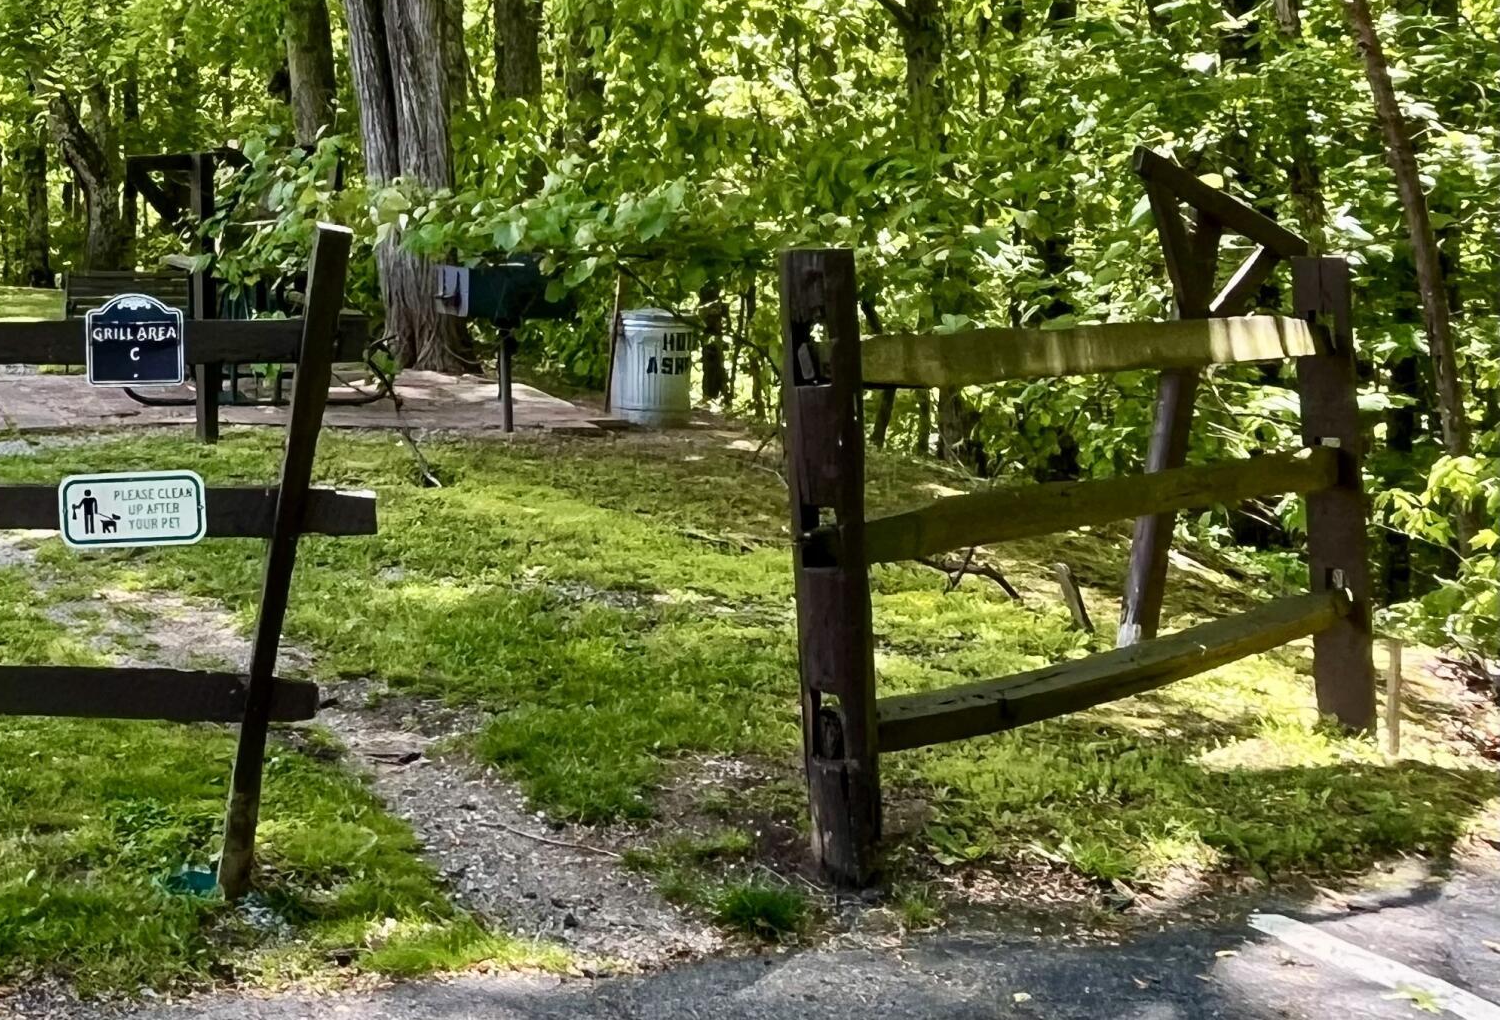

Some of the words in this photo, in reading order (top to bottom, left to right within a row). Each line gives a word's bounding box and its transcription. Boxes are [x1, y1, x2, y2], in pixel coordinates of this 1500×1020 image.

[92, 326, 134, 341] GRILL
[136, 326, 177, 341] AREA
[130, 347, 140, 361] C
[113, 488, 155, 501] PLEASE
[157, 487, 193, 500] CLEAN
[128, 504, 144, 516] UP
[146, 502, 180, 515] AFTER
[128, 518, 158, 530] YOUR
[161, 516, 181, 529] PET
